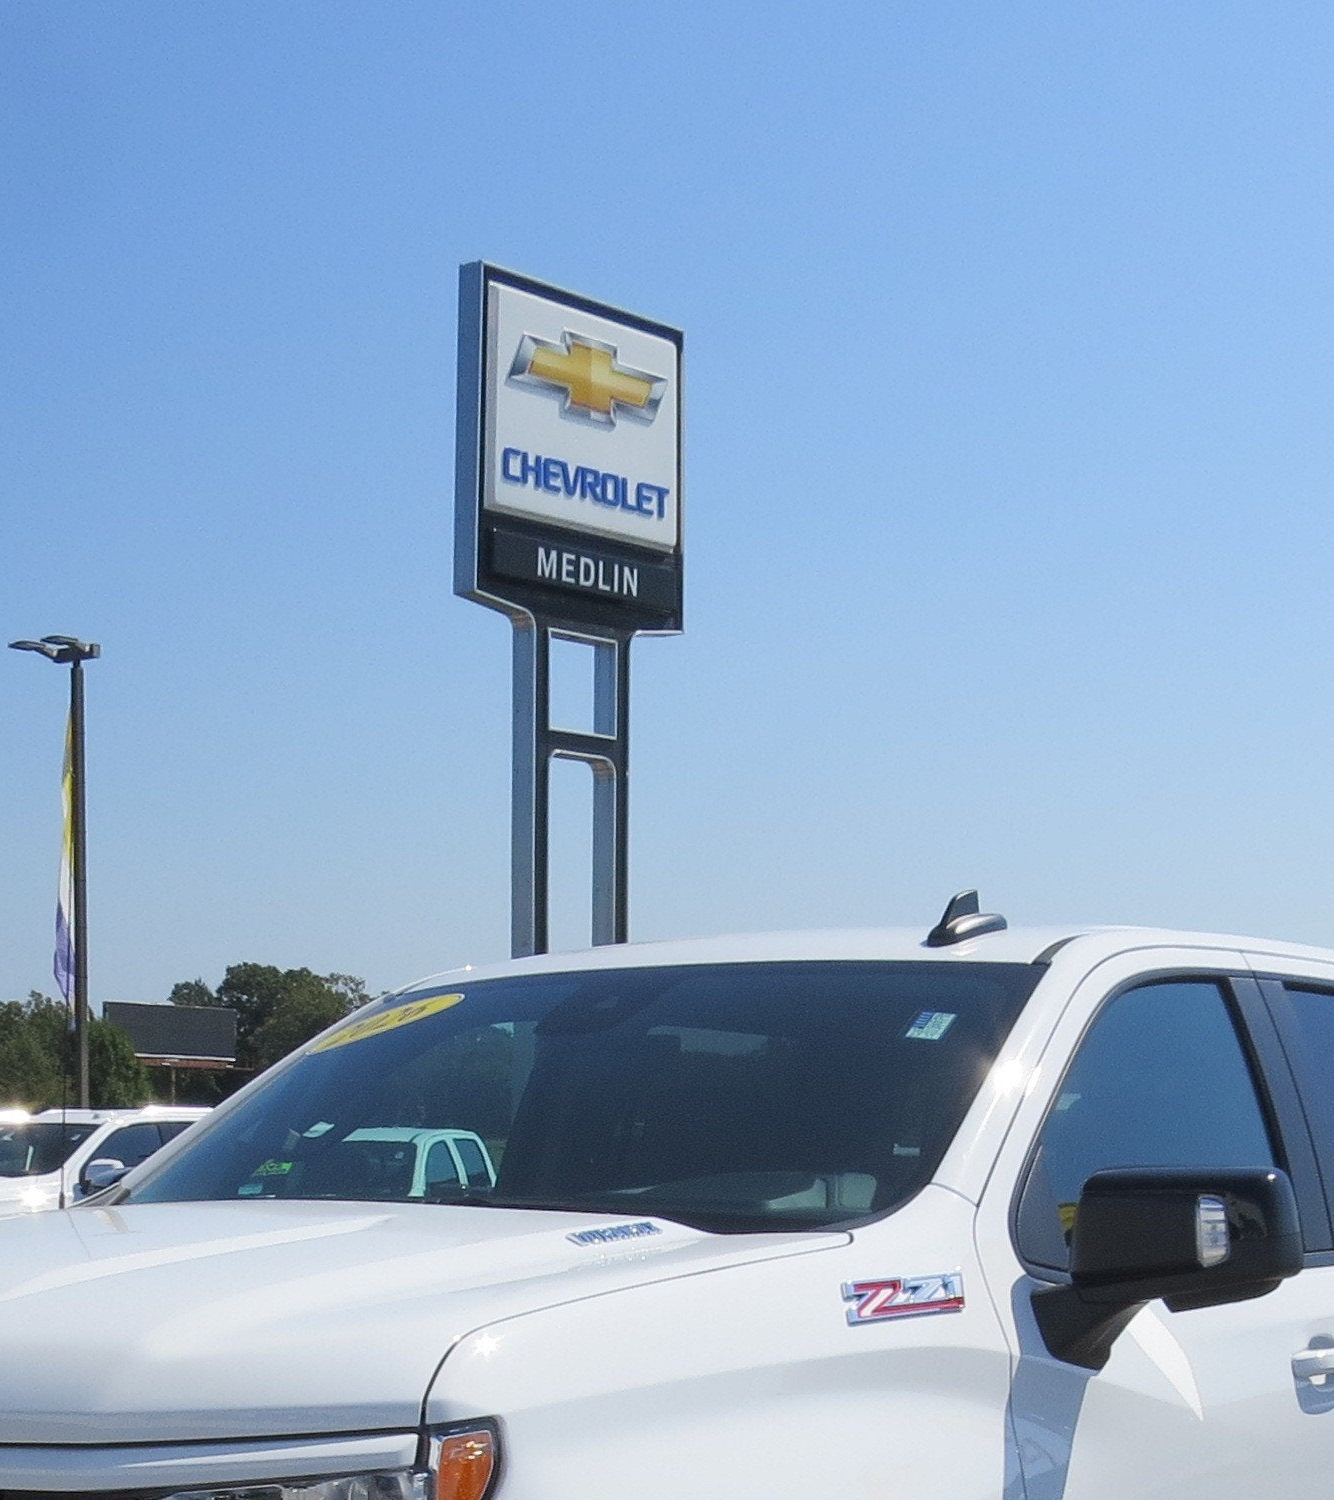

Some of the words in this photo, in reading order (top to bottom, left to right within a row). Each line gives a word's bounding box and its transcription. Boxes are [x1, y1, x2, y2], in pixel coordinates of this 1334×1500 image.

[501, 447, 670, 518] CHEVROLET
[536, 546, 639, 598] MEDLIN
[841, 1273, 965, 1327] Z71
